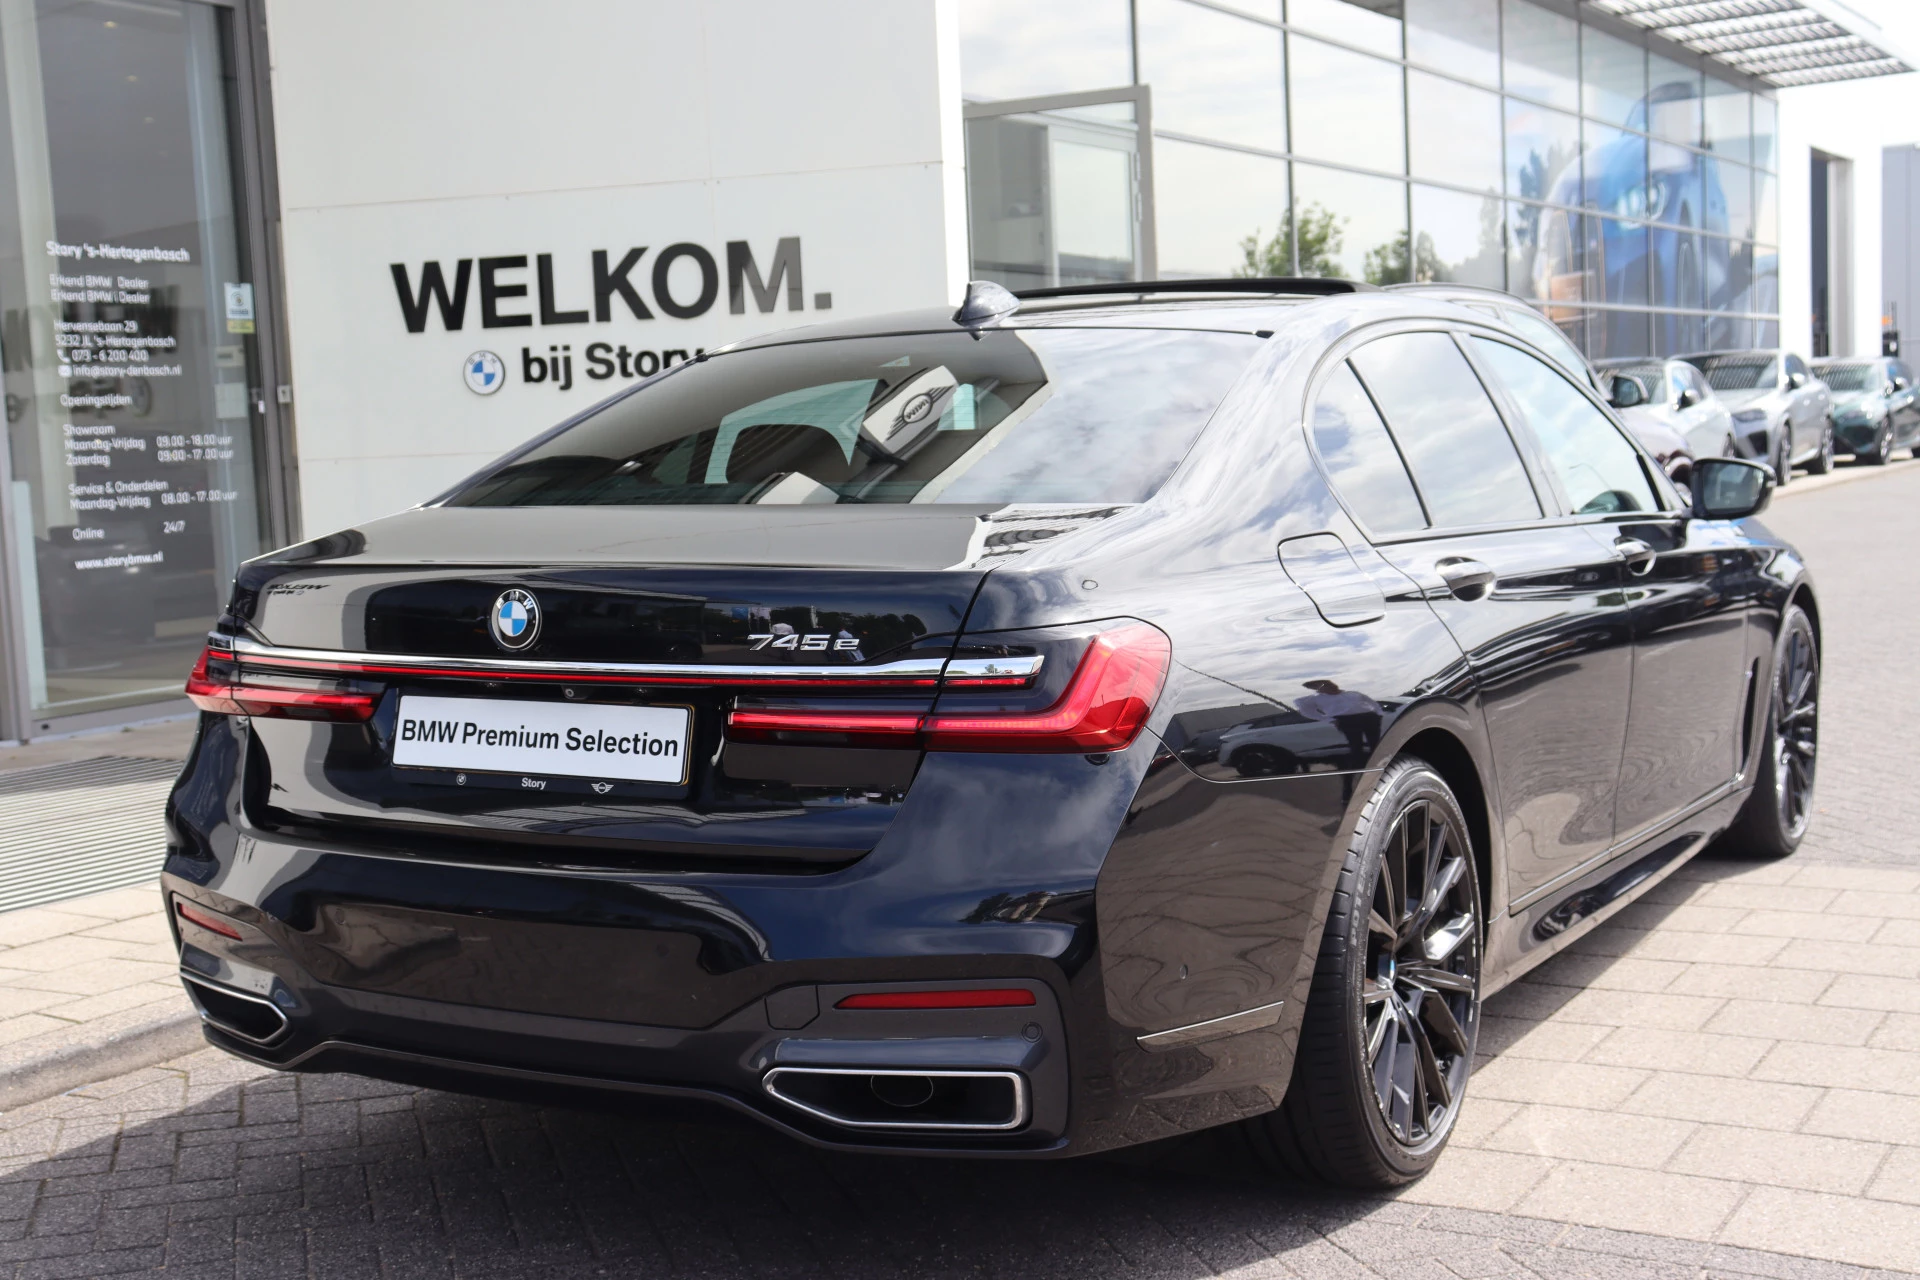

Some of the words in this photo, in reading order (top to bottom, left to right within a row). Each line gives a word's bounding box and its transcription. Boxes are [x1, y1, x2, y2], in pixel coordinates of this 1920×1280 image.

[46, 241, 82, 260] Story
[49, 274, 84, 287] Erkend
[85, 275, 112, 288] BMW
[117, 277, 149, 289] Dealer
[390, 237, 832, 333] WELKOM.
[51, 289, 86, 302] Erkend
[87, 290, 111, 303] BMW
[118, 292, 150, 304] Dealer
[123, 320, 138, 333] 29
[71, 349, 92, 362] 073
[98, 350, 107, 362] 6
[107, 350, 128, 362] 200
[128, 350, 149, 362] 400
[522, 345, 572, 390] bij
[60, 394, 132, 409] Openingstijden
[63, 424, 116, 437] Showroom
[64, 437, 146, 452] Maandag-Vrijdag
[156, 436, 184, 448] 09.00
[191, 434, 216, 446] 18.00
[217, 436, 232, 446] uur
[65, 453, 111, 468] Zaterdag
[157, 450, 185, 462] 09.00
[192, 448, 217, 460] 17.00
[219, 449, 234, 460] uur
[68, 483, 104, 495] Service
[105, 482, 114, 494] &
[115, 480, 168, 493] Onderdelen
[70, 496, 151, 511] Maandag-Vrijdag
[161, 492, 190, 505] 08.00
[196, 490, 222, 502] 17.00
[222, 490, 238, 500] uur
[72, 528, 105, 541] Online
[163, 520, 186, 534] 24/7
[75, 551, 163, 570] www.storybmw.nl
[496, 590, 534, 610] BMW
[747, 634, 860, 651] 745e
[402, 719, 459, 743] BMW
[462, 722, 559, 749] Premium
[565, 728, 679, 757] Selection
[521, 777, 546, 790] Story
